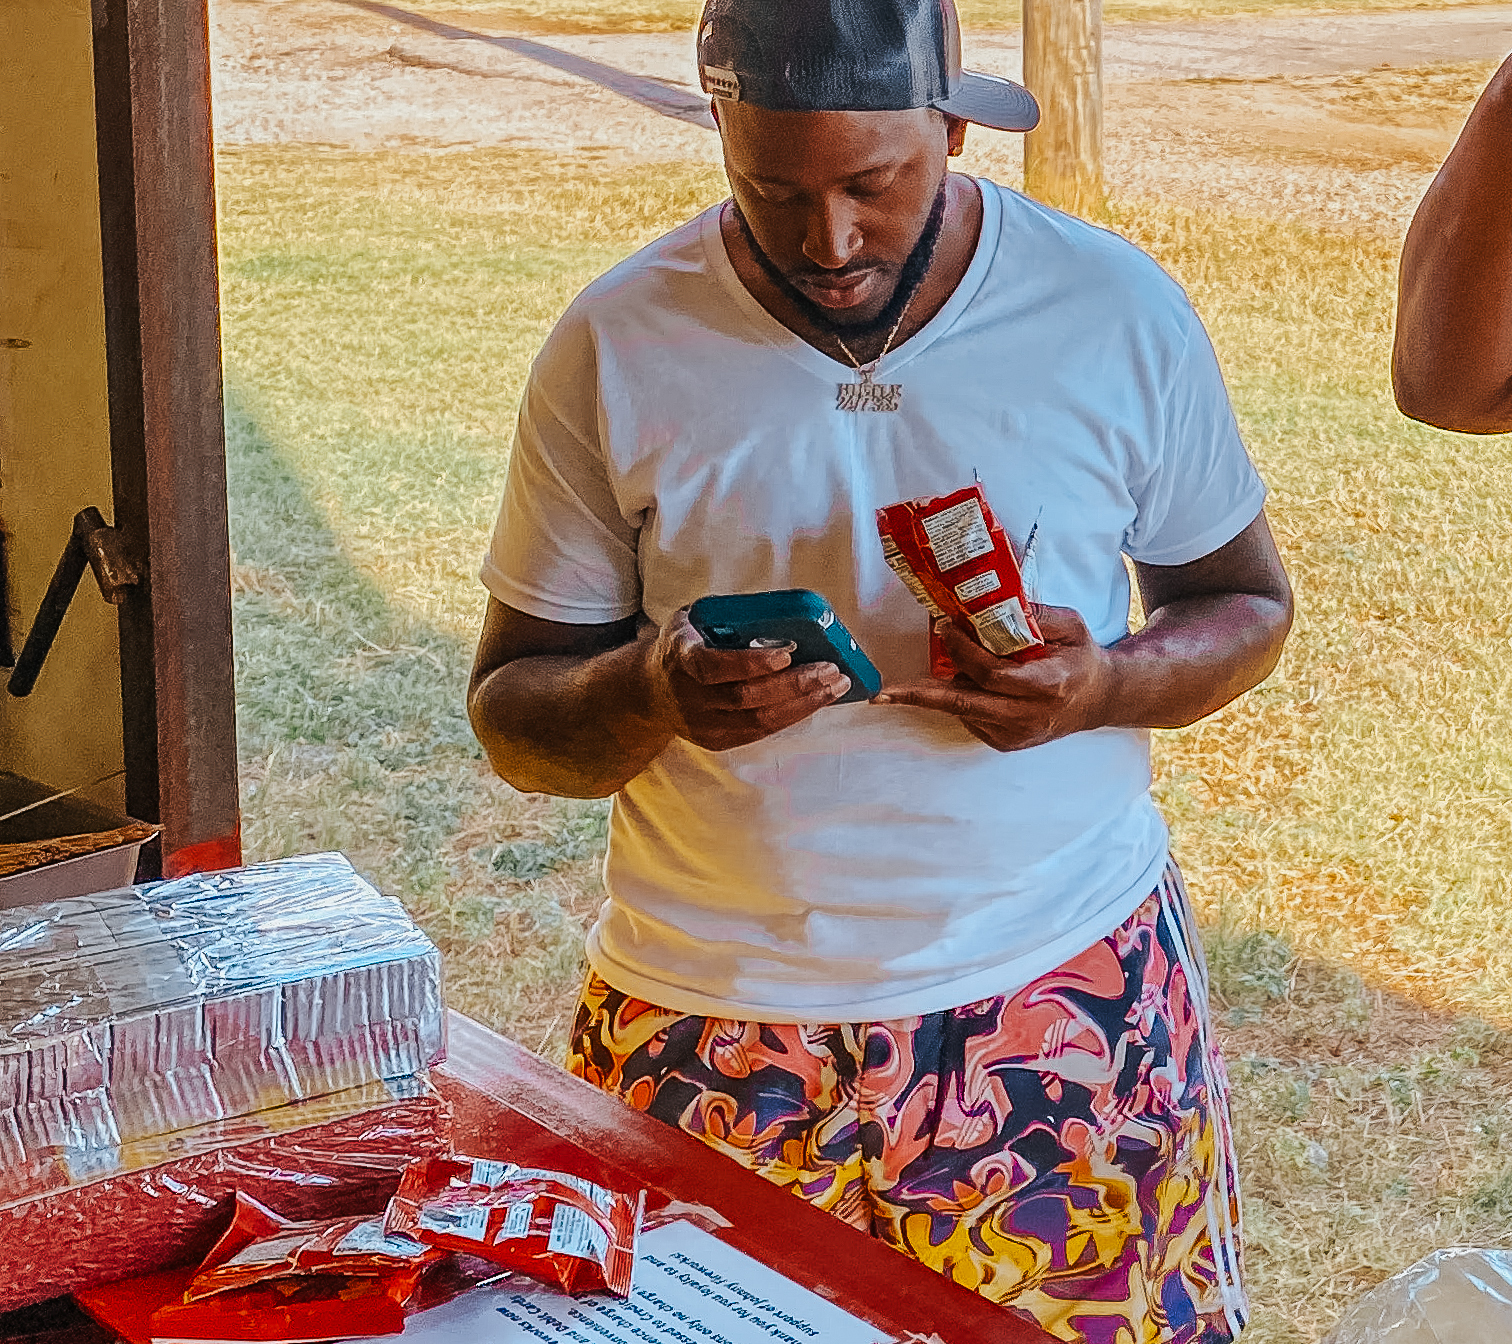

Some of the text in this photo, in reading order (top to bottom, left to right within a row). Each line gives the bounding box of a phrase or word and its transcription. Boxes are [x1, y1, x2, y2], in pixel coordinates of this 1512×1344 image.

[640, 1254, 666, 1268] and
[662, 1265, 680, 1276] to
[674, 1272, 715, 1297] loyalty
[636, 1288, 675, 1312] charge
[710, 1292, 738, 1308] you
[725, 1280, 768, 1306] Johnny
[508, 1294, 542, 1315] Cards
[729, 1306, 752, 1319] for
[757, 1302, 777, 1312] of
[494, 1306, 522, 1322] now
[536, 1312, 570, 1332] Debit
[594, 1304, 634, 1329] charge
[670, 1310, 690, 1321] no
[649, 1319, 667, 1328] to
[684, 1318, 714, 1336] only
[747, 1314, 778, 1331] you
[771, 1308, 820, 1338] support
[564, 1330, 590, 1344] and
